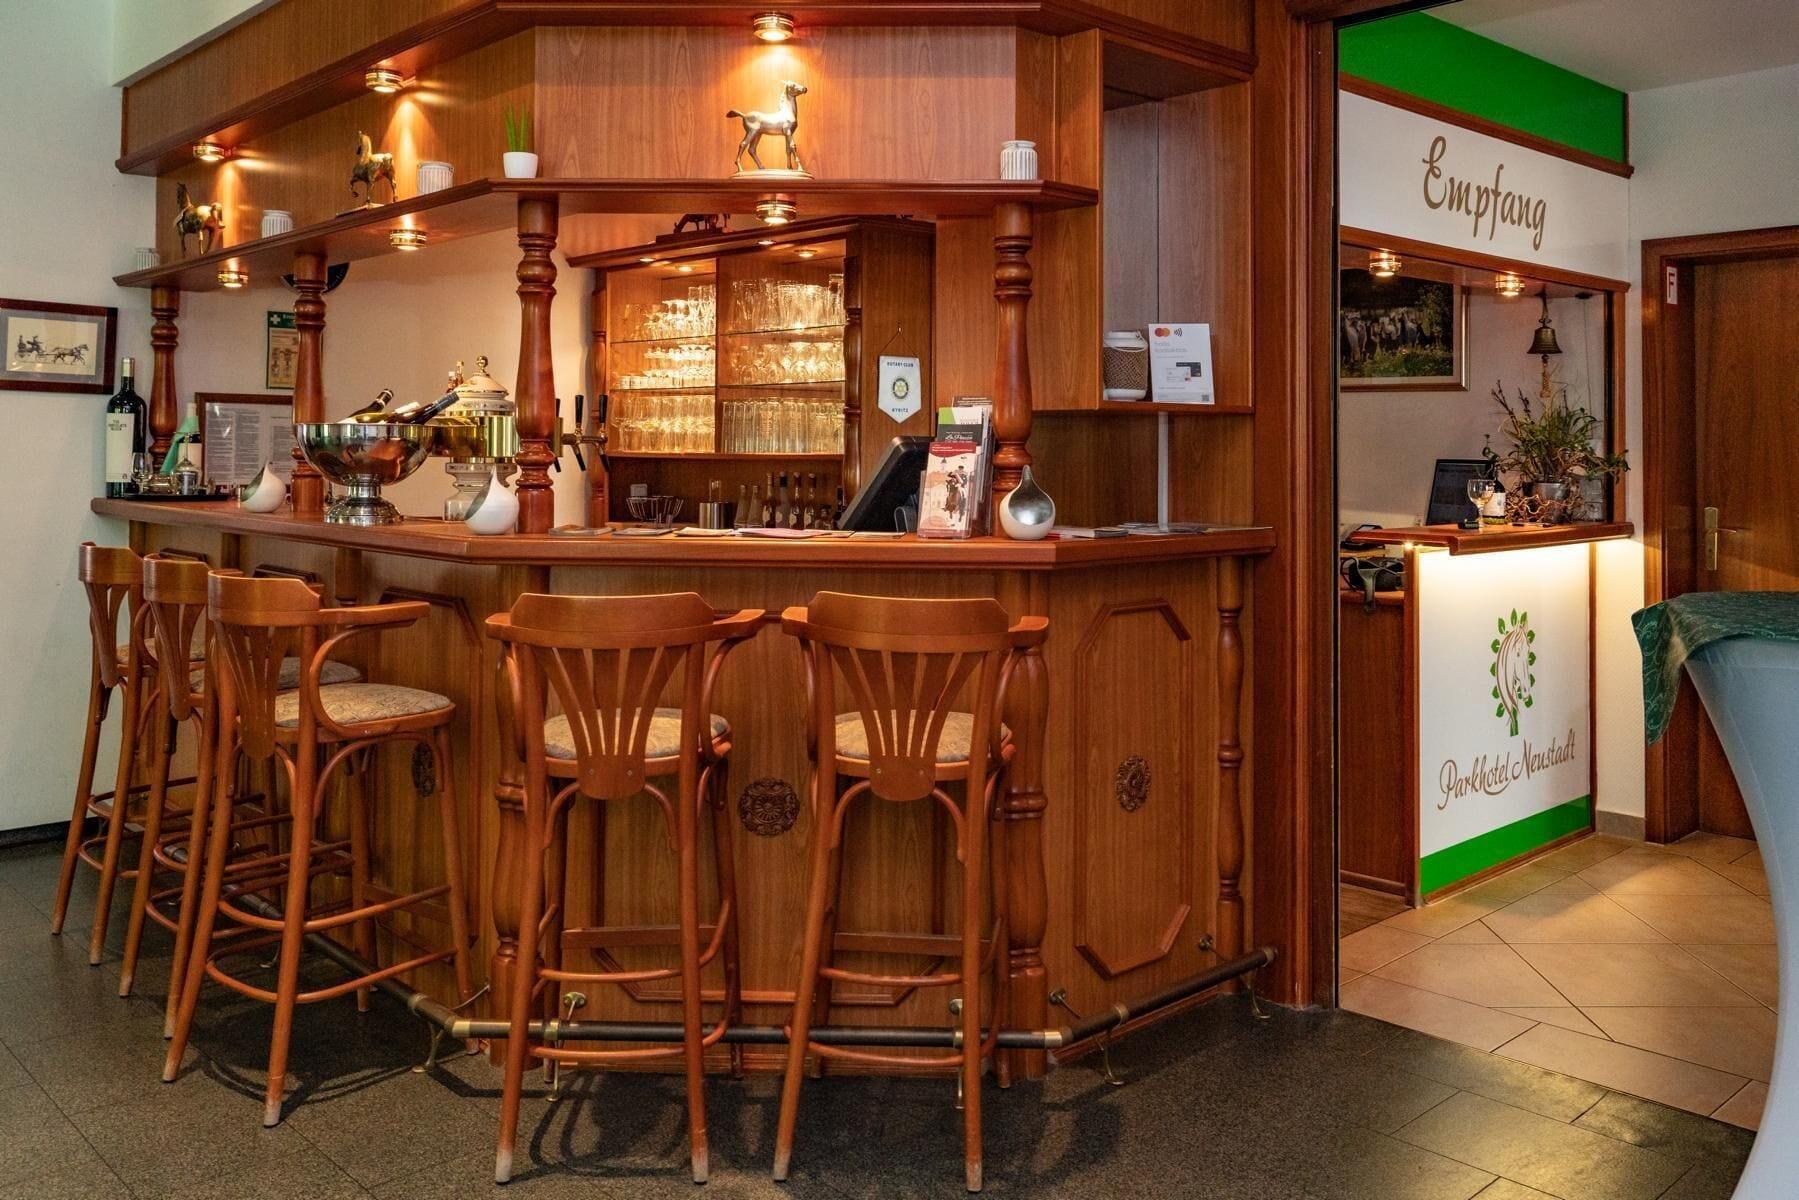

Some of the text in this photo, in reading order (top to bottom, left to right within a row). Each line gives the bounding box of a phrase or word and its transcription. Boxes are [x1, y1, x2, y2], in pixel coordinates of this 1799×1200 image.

[1422, 135, 1546, 251] Empfang
[1437, 728, 1576, 810] Parkhotel Neustadt
